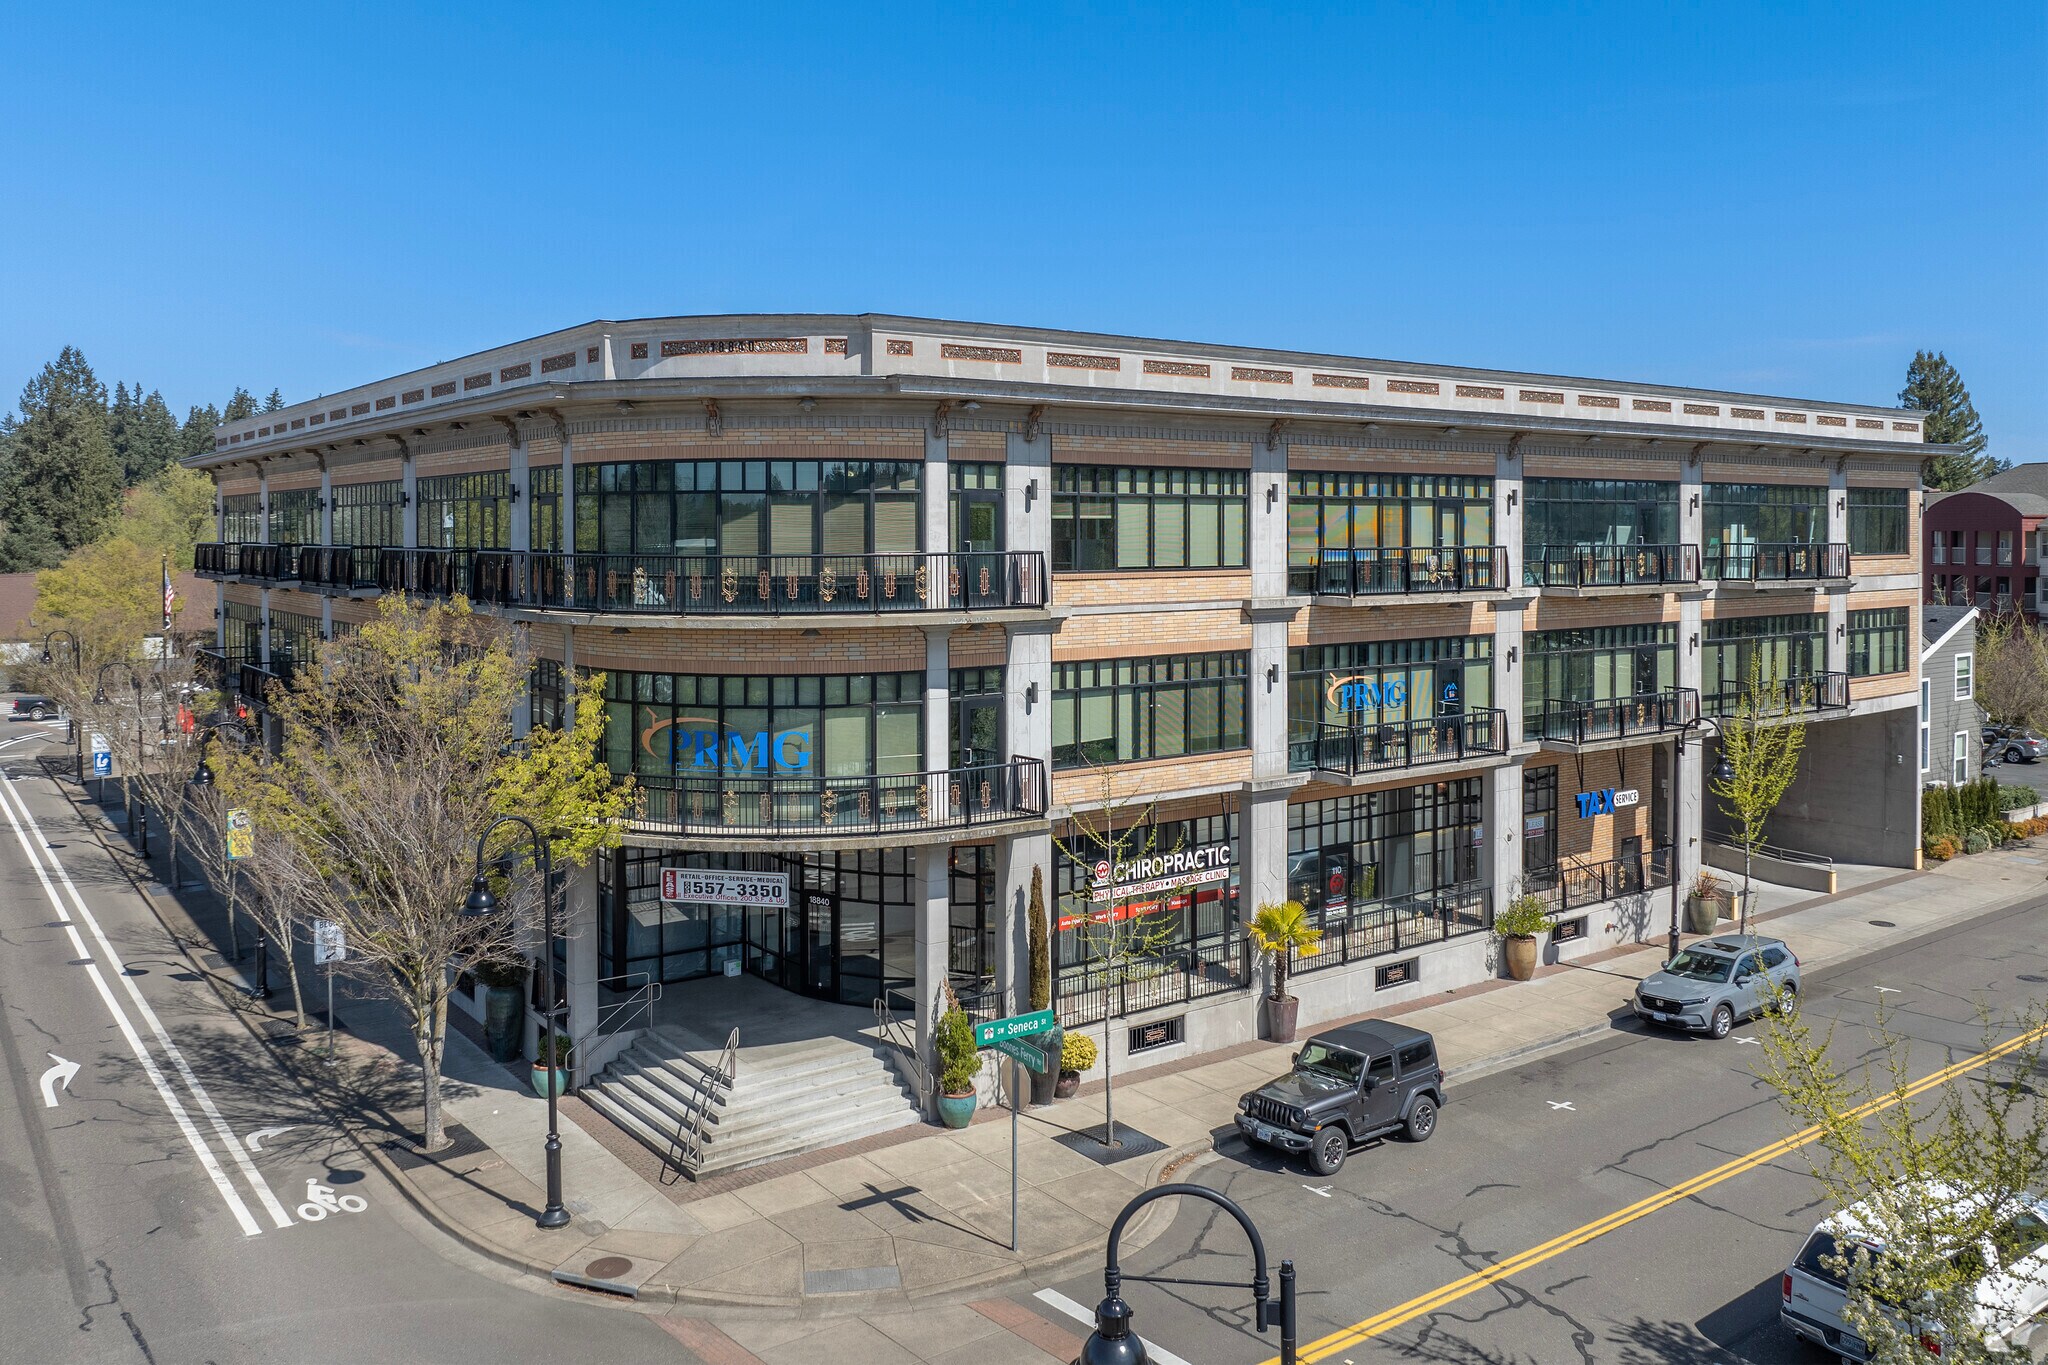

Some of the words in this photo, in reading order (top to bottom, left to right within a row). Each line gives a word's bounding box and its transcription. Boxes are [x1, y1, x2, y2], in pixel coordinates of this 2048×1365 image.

[1340, 680, 1407, 709] PRMG
[667, 728, 812, 769] PRMG
[1575, 788, 1615, 819] TAX
[1615, 791, 1637, 805] SERVICE
[1113, 845, 1230, 882] CHIROPRACTIC
[1094, 886, 1129, 900] PHYICAL
[1131, 881, 1164, 894] THERAPY
[1170, 874, 1203, 887] MASSAGE
[1205, 869, 1227, 880] CLINIC
[775, 897, 785, 905] Up
[809, 895, 830, 907] 18840
[997, 1027, 1005, 1035] SW
[1008, 1020, 1038, 1035] Seneca
[999, 1041, 1019, 1056] Boones
[1020, 1046, 1036, 1068] Ferry
